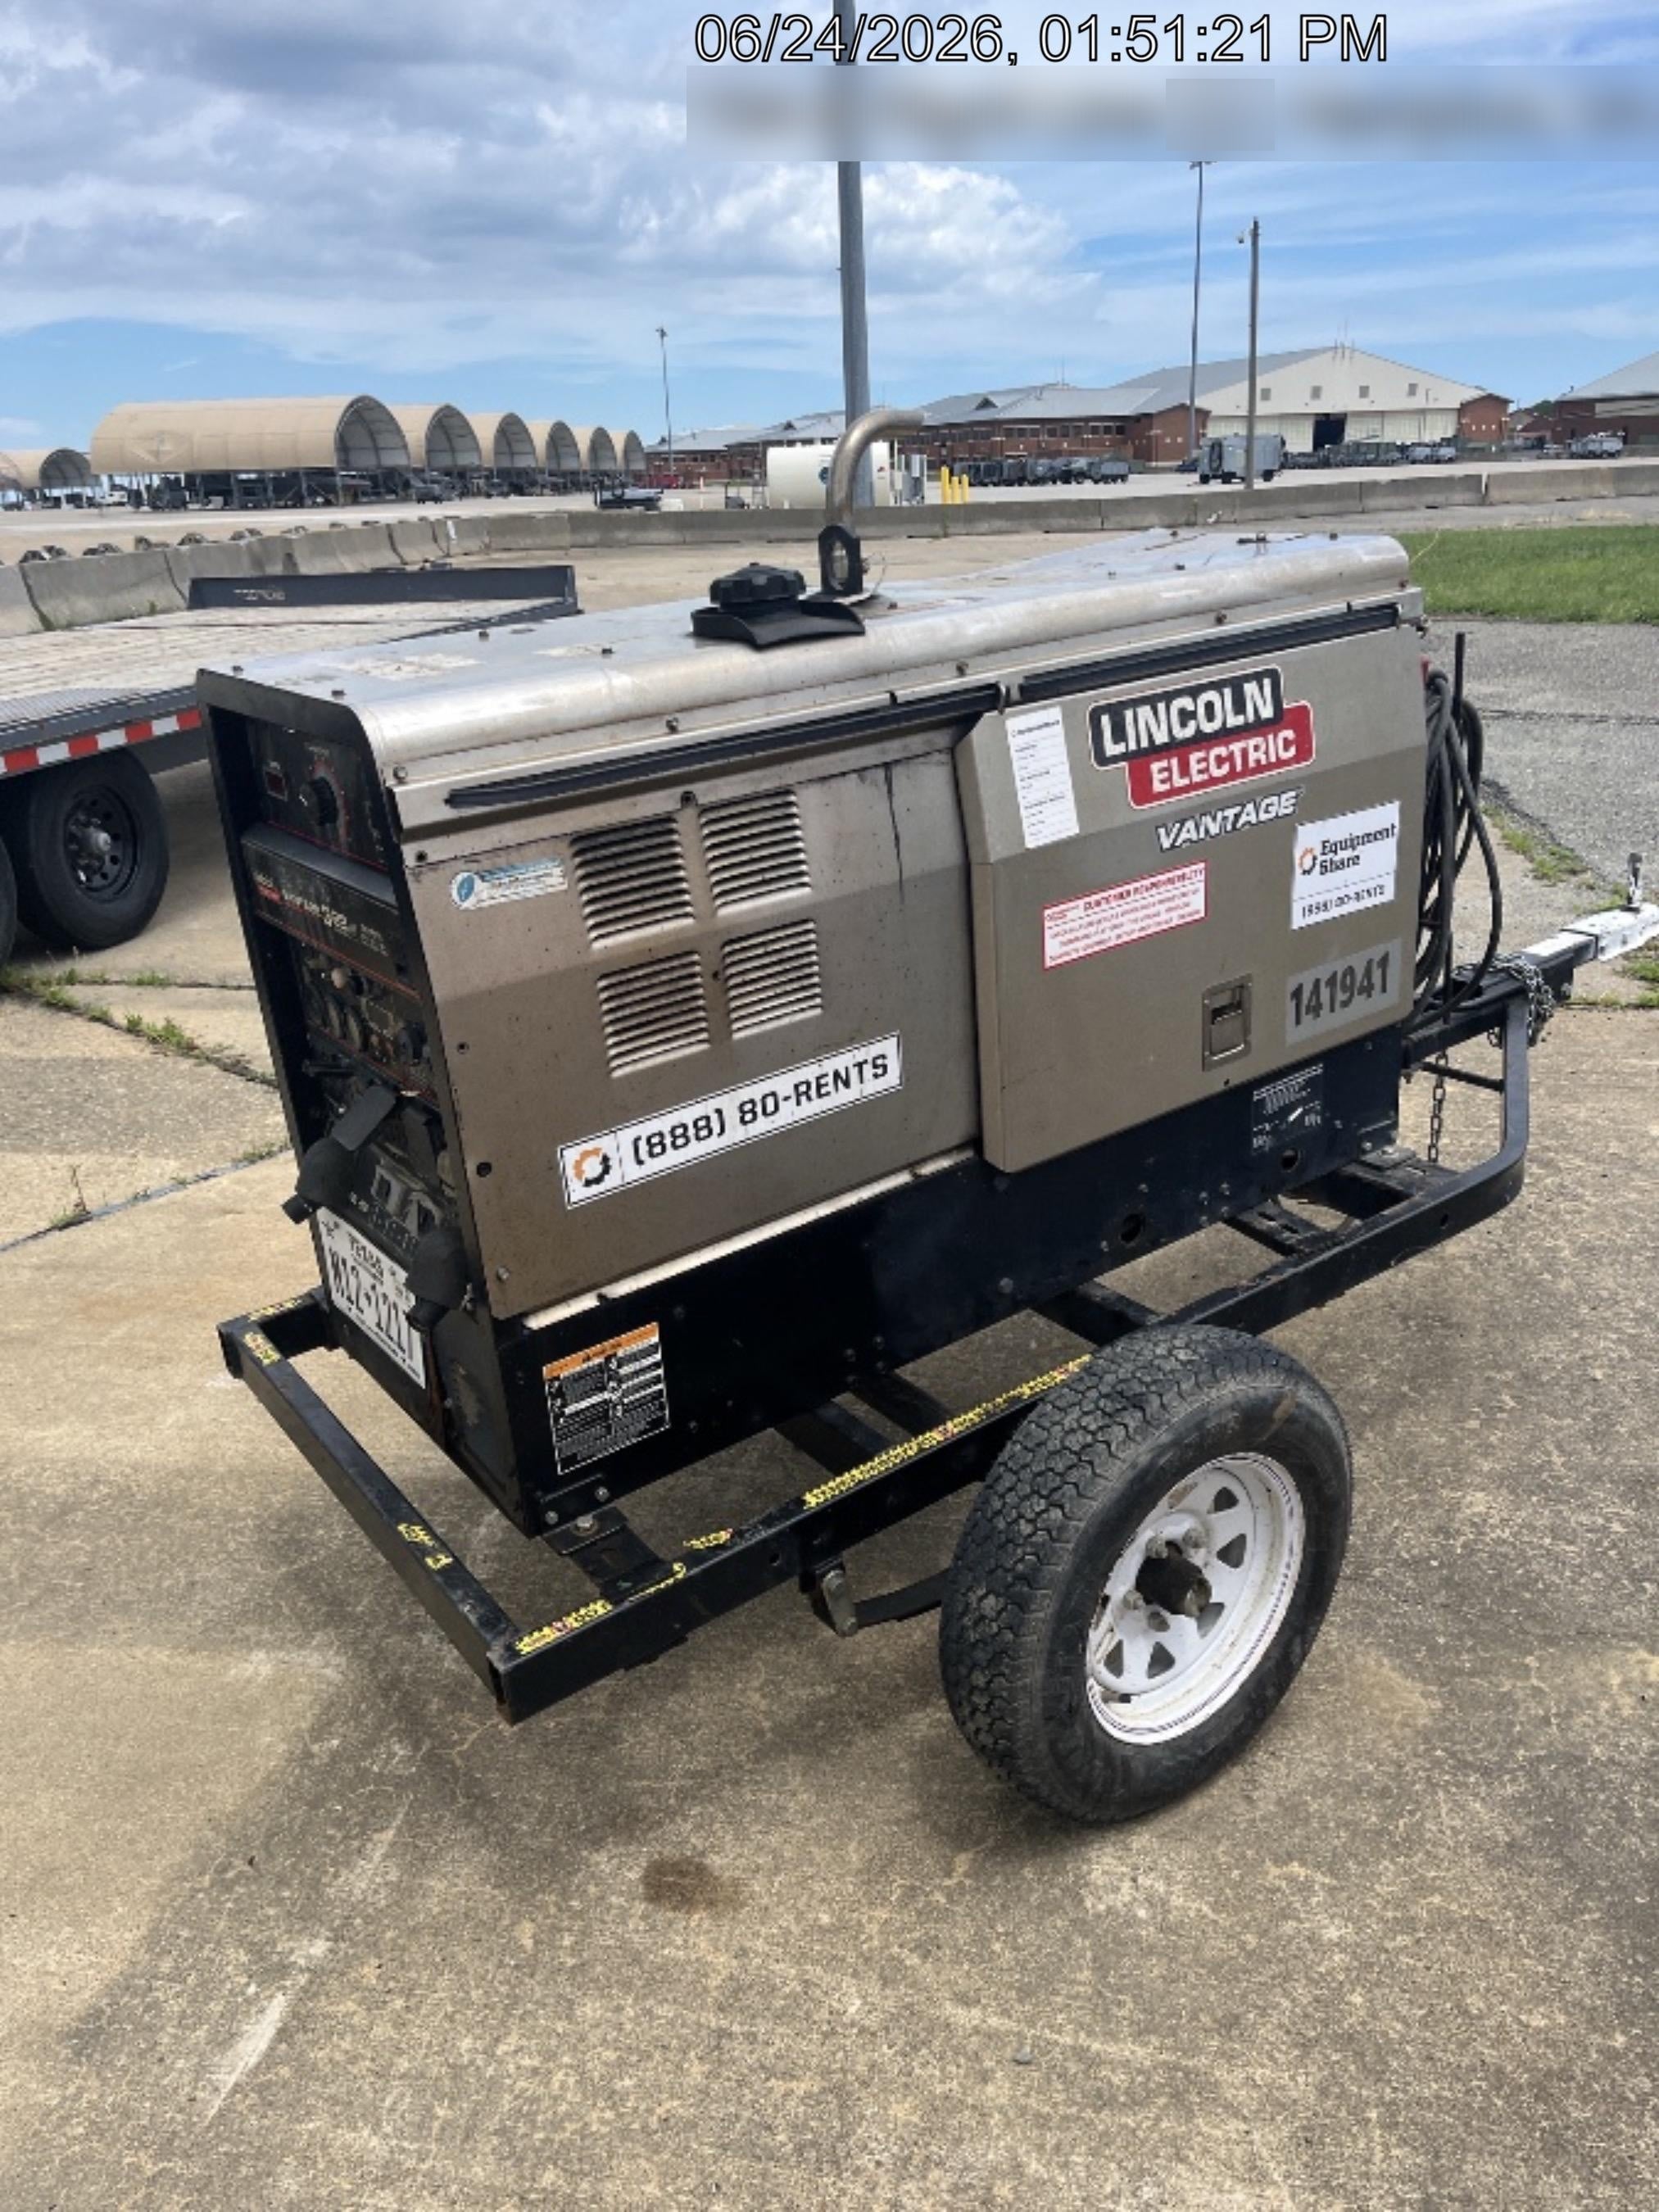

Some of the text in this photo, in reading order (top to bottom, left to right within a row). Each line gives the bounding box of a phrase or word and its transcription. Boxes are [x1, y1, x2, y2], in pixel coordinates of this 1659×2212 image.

[1099, 678, 1275, 758] LINCOLN
[1149, 729, 1297, 794] ELECTRIC
[1155, 789, 1298, 852] VANTAGE
[1320, 823, 1397, 857] Equipment
[1318, 854, 1361, 876] Share
[1290, 950, 1390, 1028] 141941
[632, 1054, 889, 1166] (888) 80-RENTS
